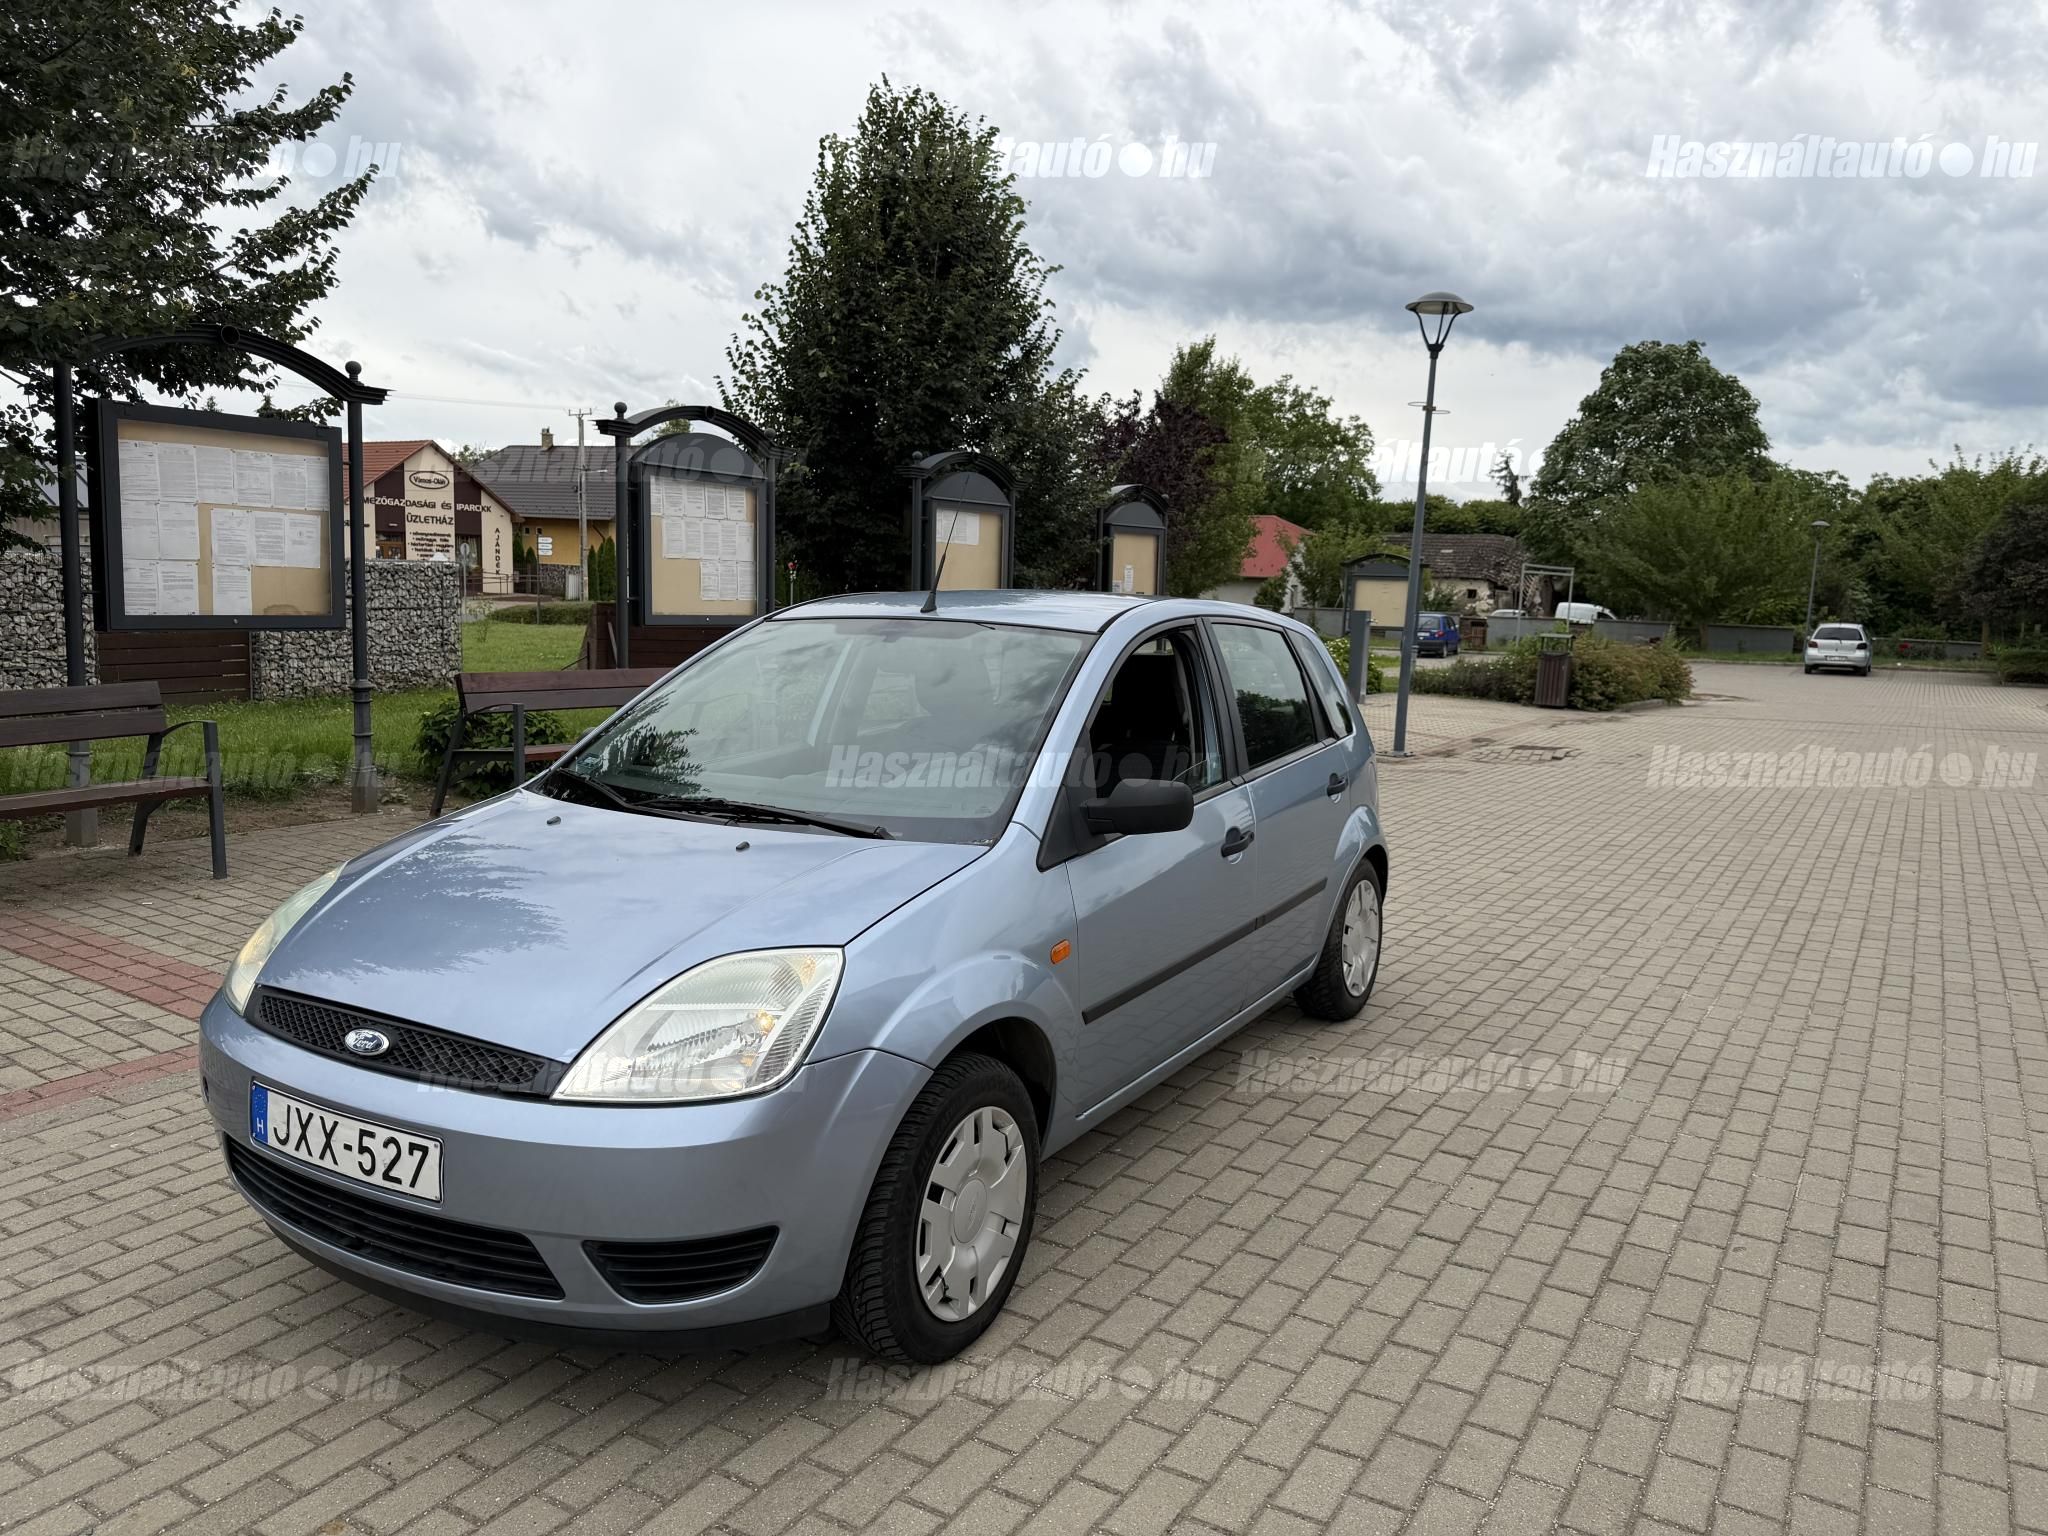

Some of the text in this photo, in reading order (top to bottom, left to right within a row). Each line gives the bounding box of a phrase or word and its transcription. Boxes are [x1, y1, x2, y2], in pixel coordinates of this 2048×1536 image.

[441, 500, 452, 510] ÉS
[406, 513, 454, 525] ÜZLETHÁZ
[256, 1104, 430, 1189] H JXX-527
